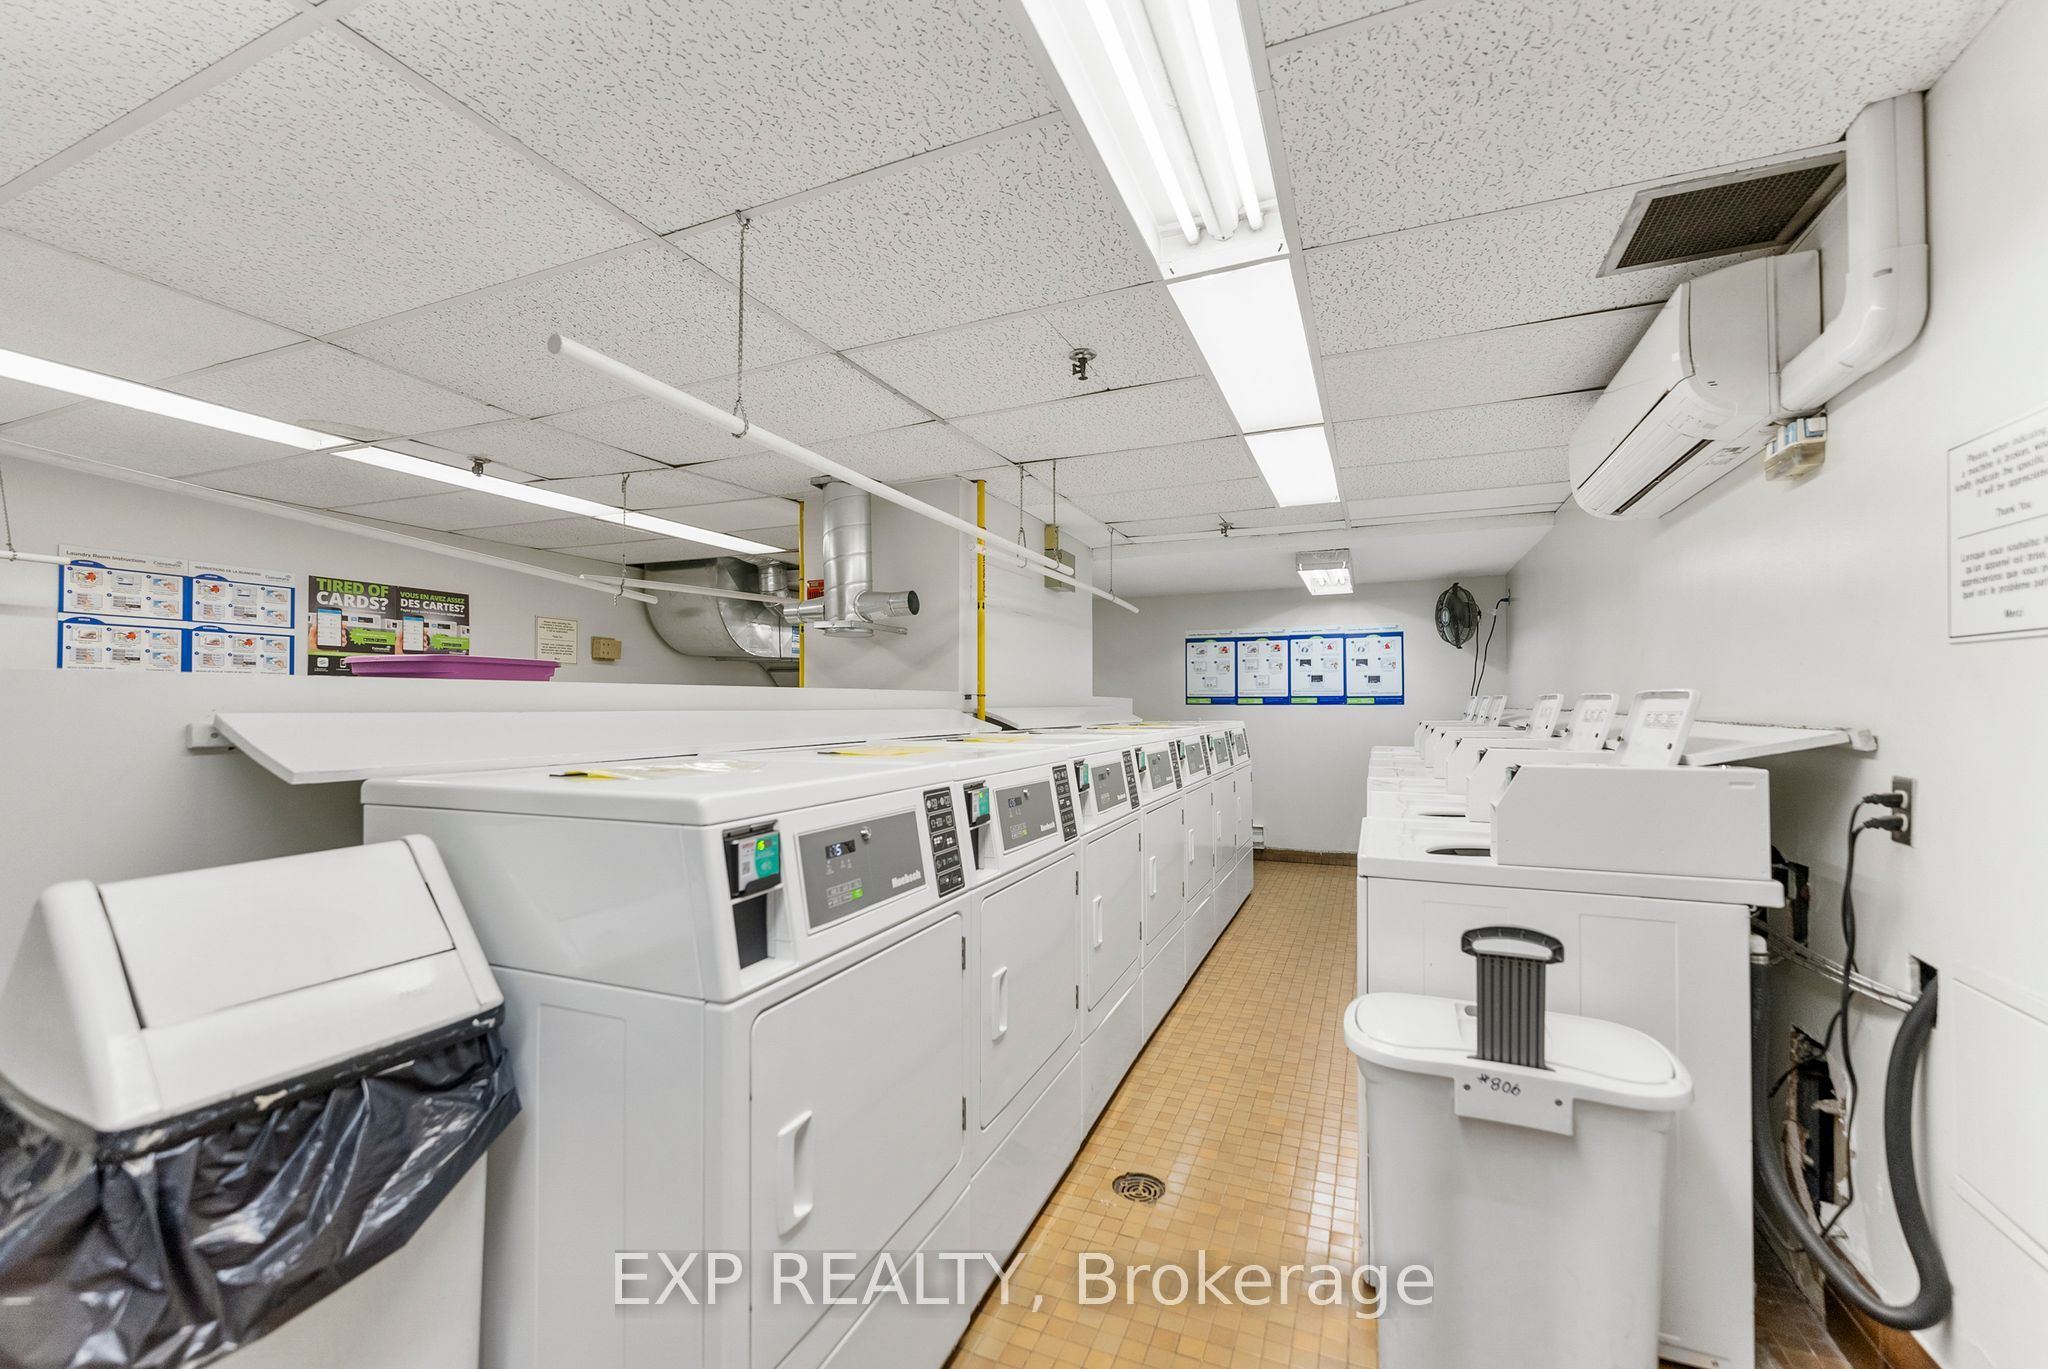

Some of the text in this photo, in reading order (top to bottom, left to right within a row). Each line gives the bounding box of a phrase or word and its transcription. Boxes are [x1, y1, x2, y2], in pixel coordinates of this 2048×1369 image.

[66, 550, 91, 559] Laundry
[112, 555, 146, 564] Instructions
[316, 577, 389, 597] TIRED OF
[316, 591, 389, 611] CARDS?
[400, 591, 419, 599] VOUS
[400, 598, 465, 613] DES CARTES?
